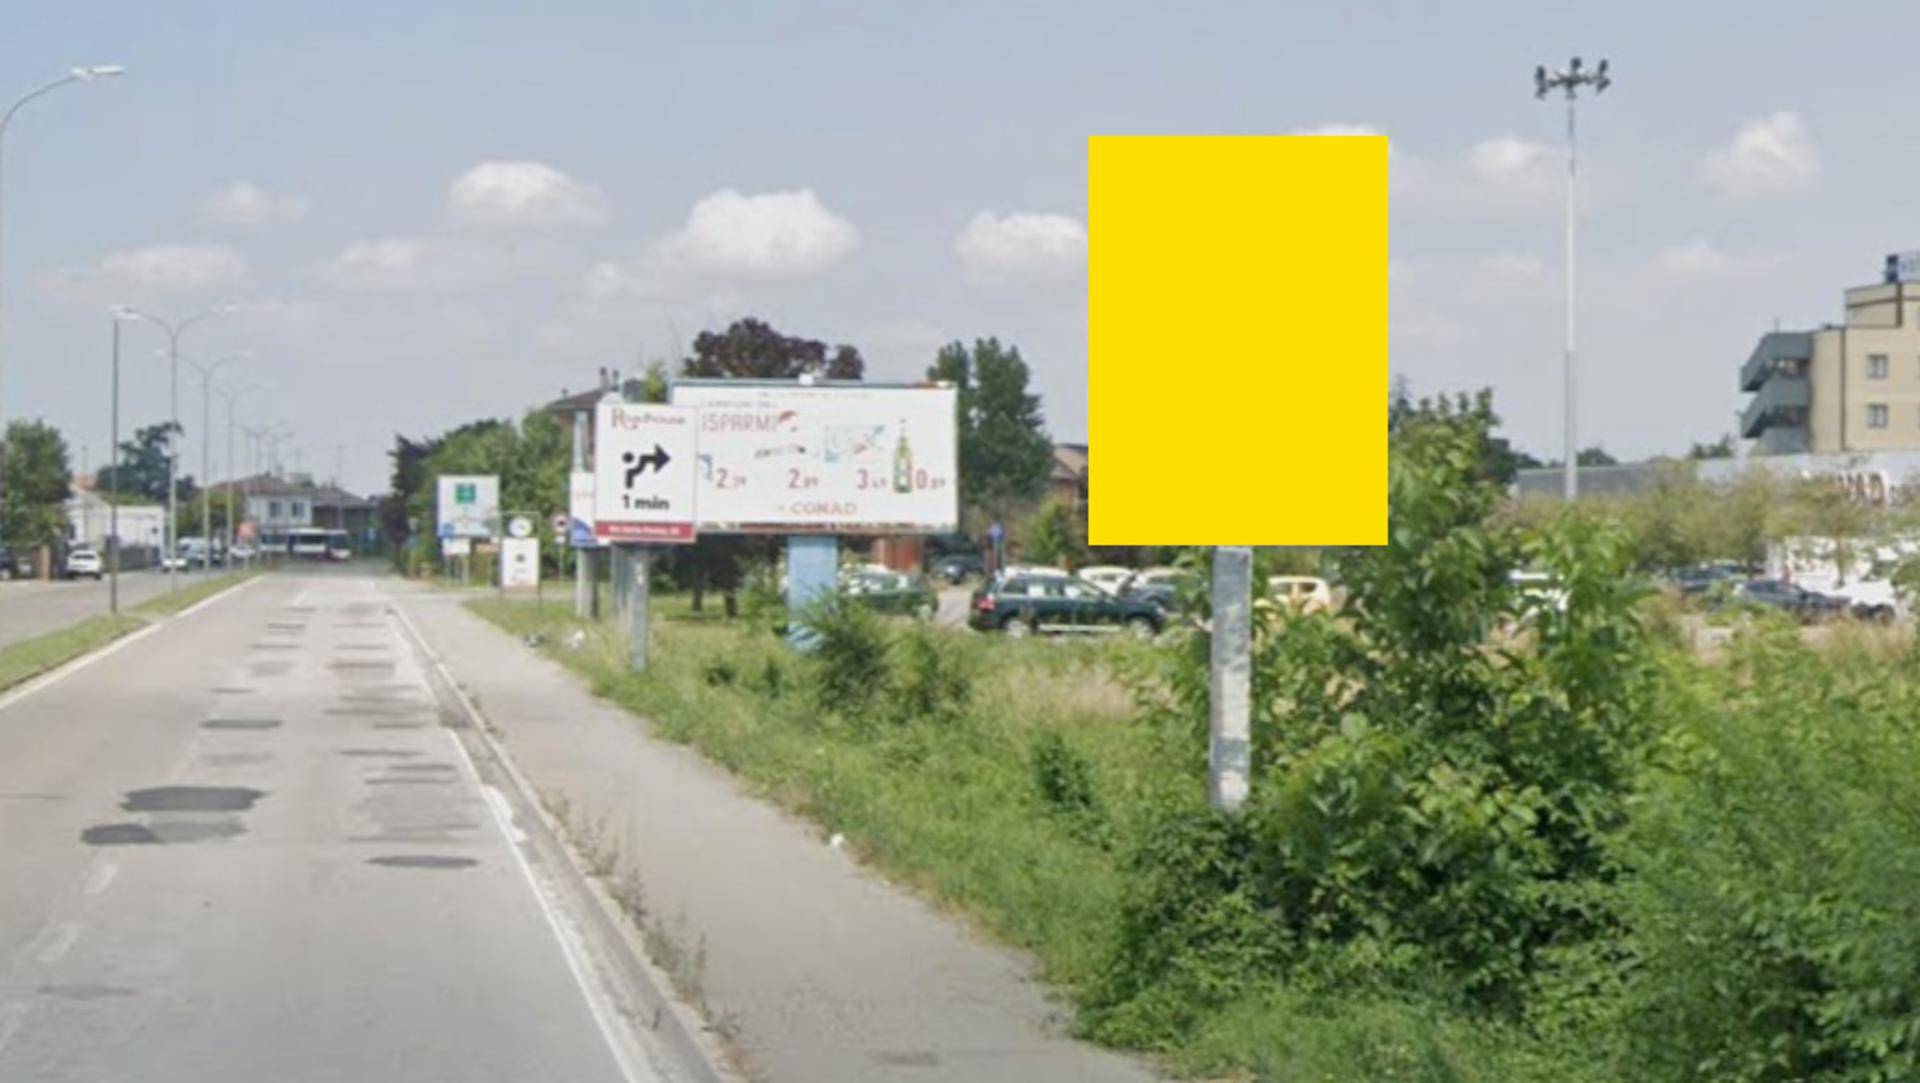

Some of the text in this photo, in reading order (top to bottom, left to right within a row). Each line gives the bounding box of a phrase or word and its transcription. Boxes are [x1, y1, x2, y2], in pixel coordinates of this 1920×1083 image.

[622, 494, 670, 510] 1 min
[791, 501, 858, 516] CONAD
